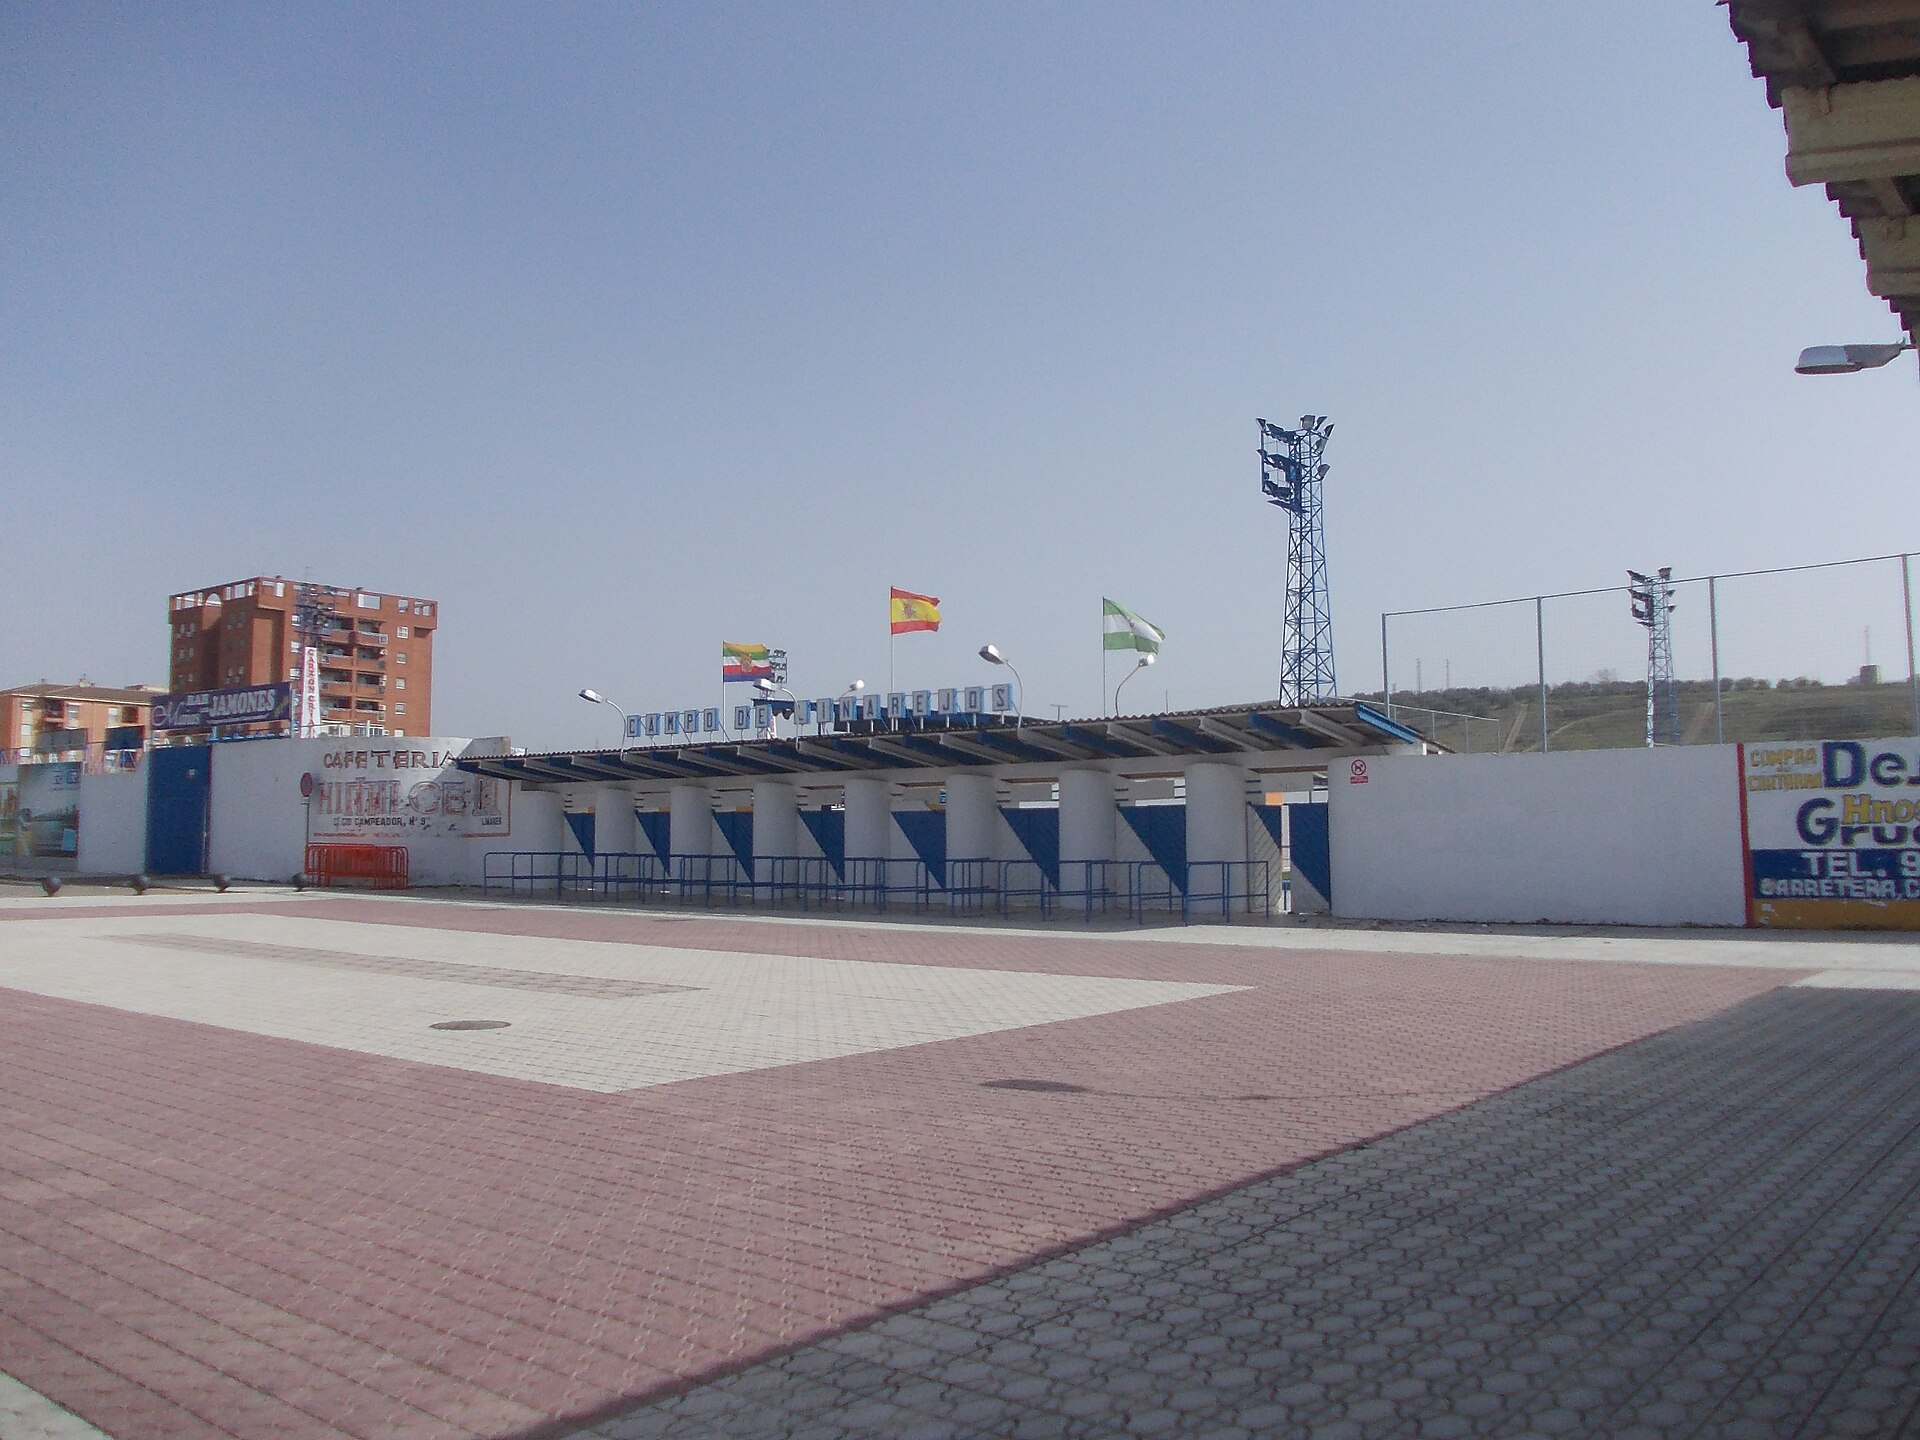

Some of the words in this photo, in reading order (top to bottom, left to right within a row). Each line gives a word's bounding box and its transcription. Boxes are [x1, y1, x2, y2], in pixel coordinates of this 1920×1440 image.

[209, 689, 276, 718] JAMONES
[628, 707, 718, 735] CAMPO
[736, 705, 767, 726] DE
[323, 749, 456, 769] CAFETERIA
